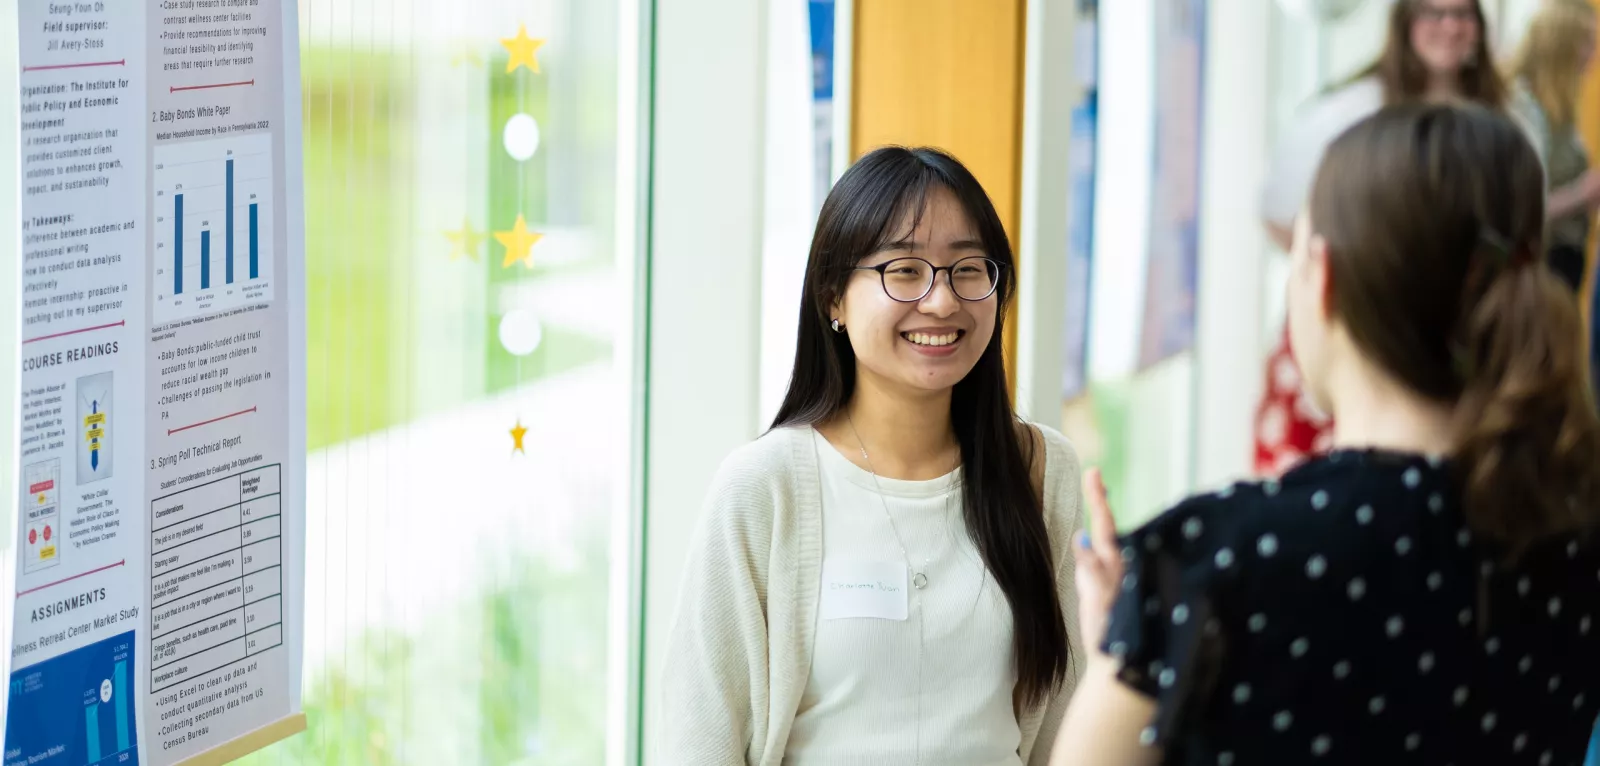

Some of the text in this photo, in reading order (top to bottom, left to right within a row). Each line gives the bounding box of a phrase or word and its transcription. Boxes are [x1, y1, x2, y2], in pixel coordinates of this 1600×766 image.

[163, 1, 178, 10] Case
[180, 0, 194, 10] study
[197, 0, 219, 8] research
[164, 12, 251, 24] contrast wellness center facilities
[44, 20, 108, 33] Field supervisor:
[164, 31, 185, 40] Provide
[187, 28, 231, 39] recommendations
[242, 26, 266, 36] improving
[48, 40, 58, 51] Jill
[164, 41, 253, 55] financial feasibility and identifying
[164, 55, 253, 70] areas that require further research
[71, 79, 129, 91] The Institute for
[43, 96, 118, 111] Policy and Economic
[152, 106, 230, 123] 2. Baby Bonds White Paper
[33, 129, 118, 145] research organization that
[173, 128, 194, 138] Household
[196, 127, 211, 136] Income
[212, 126, 216, 135] by
[257, 120, 269, 129] 2022
[27, 145, 112, 164] provides customized client
[27, 160, 122, 178] solutions to enhances growth,
[51, 177, 109, 192] and sustainability
[32, 214, 74, 227] Takeaways:
[60, 220, 134, 239] between academic and
[67, 243, 88, 253] writing
[48, 262, 74, 273] conduct
[77, 259, 90, 268] data
[93, 254, 121, 265] analysis
[88, 288, 119, 299] proactive
[54, 300, 122, 319] out to my supervisor
[161, 330, 261, 361] Baby child trust
[23, 341, 119, 372] COURSE READINGS
[161, 362, 186, 375] accounts
[198, 358, 208, 366] low
[210, 353, 227, 364] income
[229, 348, 249, 359] children
[252, 345, 257, 353] to
[161, 367, 228, 390] reduce racial wealth gap
[161, 390, 192, 405] Challenges
[194, 388, 200, 397] of
[202, 384, 222, 396] passing
[234, 373, 262, 387] legislation
[265, 370, 271, 379] in
[161, 411, 169, 420] PA
[151, 435, 241, 470] 3. Spring Poll Technical Report
[178, 470, 205, 484] Considerations
[212, 462, 230, 474] Evaluating
[238, 454, 262, 466] Opportunities
[242, 477, 260, 487] Weighted
[242, 485, 258, 495] Average
[156, 504, 183, 519] Considerations
[91, 524, 103, 533] Policy
[105, 520, 120, 529] Making
[182, 527, 195, 536] desired
[169, 555, 179, 564] salary
[178, 560, 231, 583] makes making
[167, 585, 179, 595] impact
[31, 588, 106, 623] ASSIGNMENTS
[201, 590, 224, 608] region where
[40, 605, 139, 648] Retreat Center Market Study
[182, 633, 192, 642] such
[198, 627, 209, 636] health
[154, 666, 188, 684] Workplace culture
[160, 693, 177, 706] Using
[180, 686, 196, 699] Excel
[206, 677, 222, 688] clean
[224, 674, 231, 682] up
[233, 668, 246, 678] data
[248, 662, 257, 672] and
[161, 681, 248, 720] conduct quantitative analysis
[162, 688, 263, 735] Collecting secondary data from US
[163, 726, 209, 750] Census Bureau
